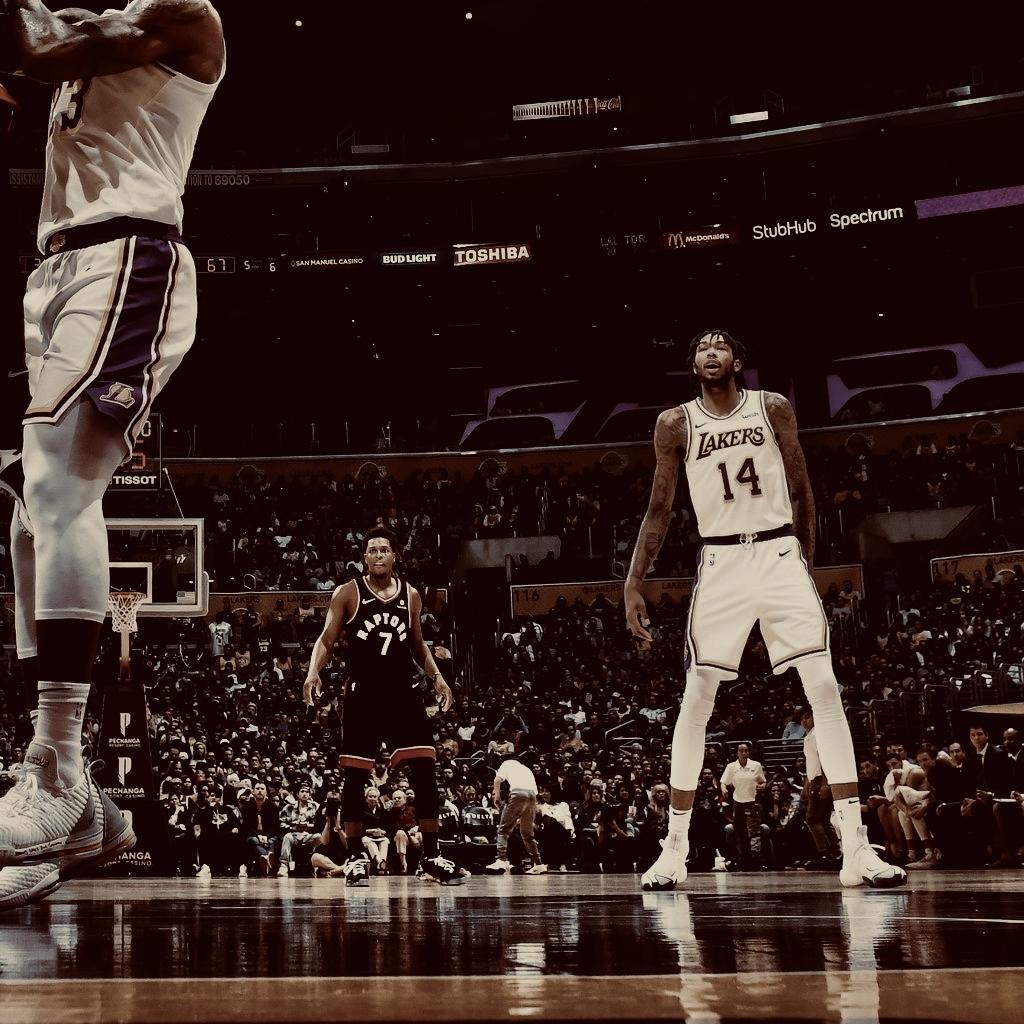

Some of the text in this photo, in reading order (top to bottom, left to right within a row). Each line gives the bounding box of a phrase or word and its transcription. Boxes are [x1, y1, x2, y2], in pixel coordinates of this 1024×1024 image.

[214, 174, 250, 186] 69050
[829, 205, 904, 231] Spectrum
[751, 219, 817, 240] StubHub
[685, 232, 730, 243] McDonald's
[295, 257, 364, 267] SAN MANUEL CASINO
[382, 253, 437, 264] BUD LIGHT
[454, 245, 530, 264] TOSHIBA
[696, 426, 766, 461] LAKERS
[112, 475, 157, 485] TISSOT
[717, 457, 763, 502] 14
[379, 631, 393, 656] 7
[103, 787, 145, 795] PECHANGA
